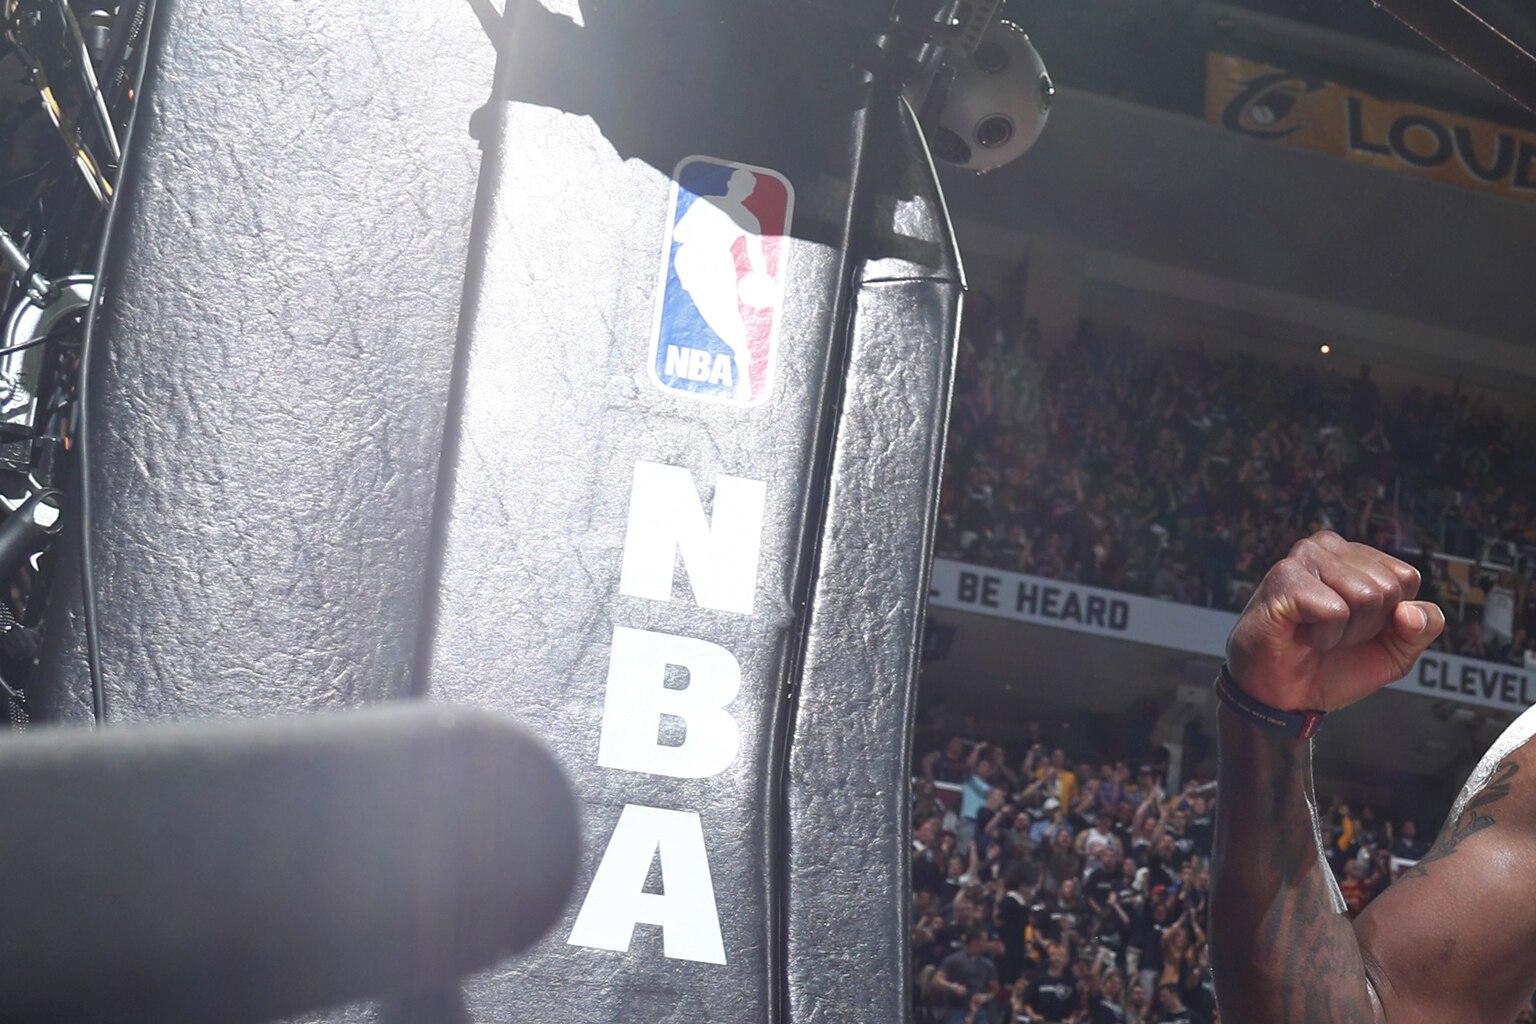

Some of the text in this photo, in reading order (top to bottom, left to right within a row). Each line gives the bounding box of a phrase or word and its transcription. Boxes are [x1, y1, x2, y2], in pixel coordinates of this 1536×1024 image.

[664, 344, 734, 388] NBA
[957, 571, 1002, 608] BE
[1016, 581, 1131, 631] HEARD
